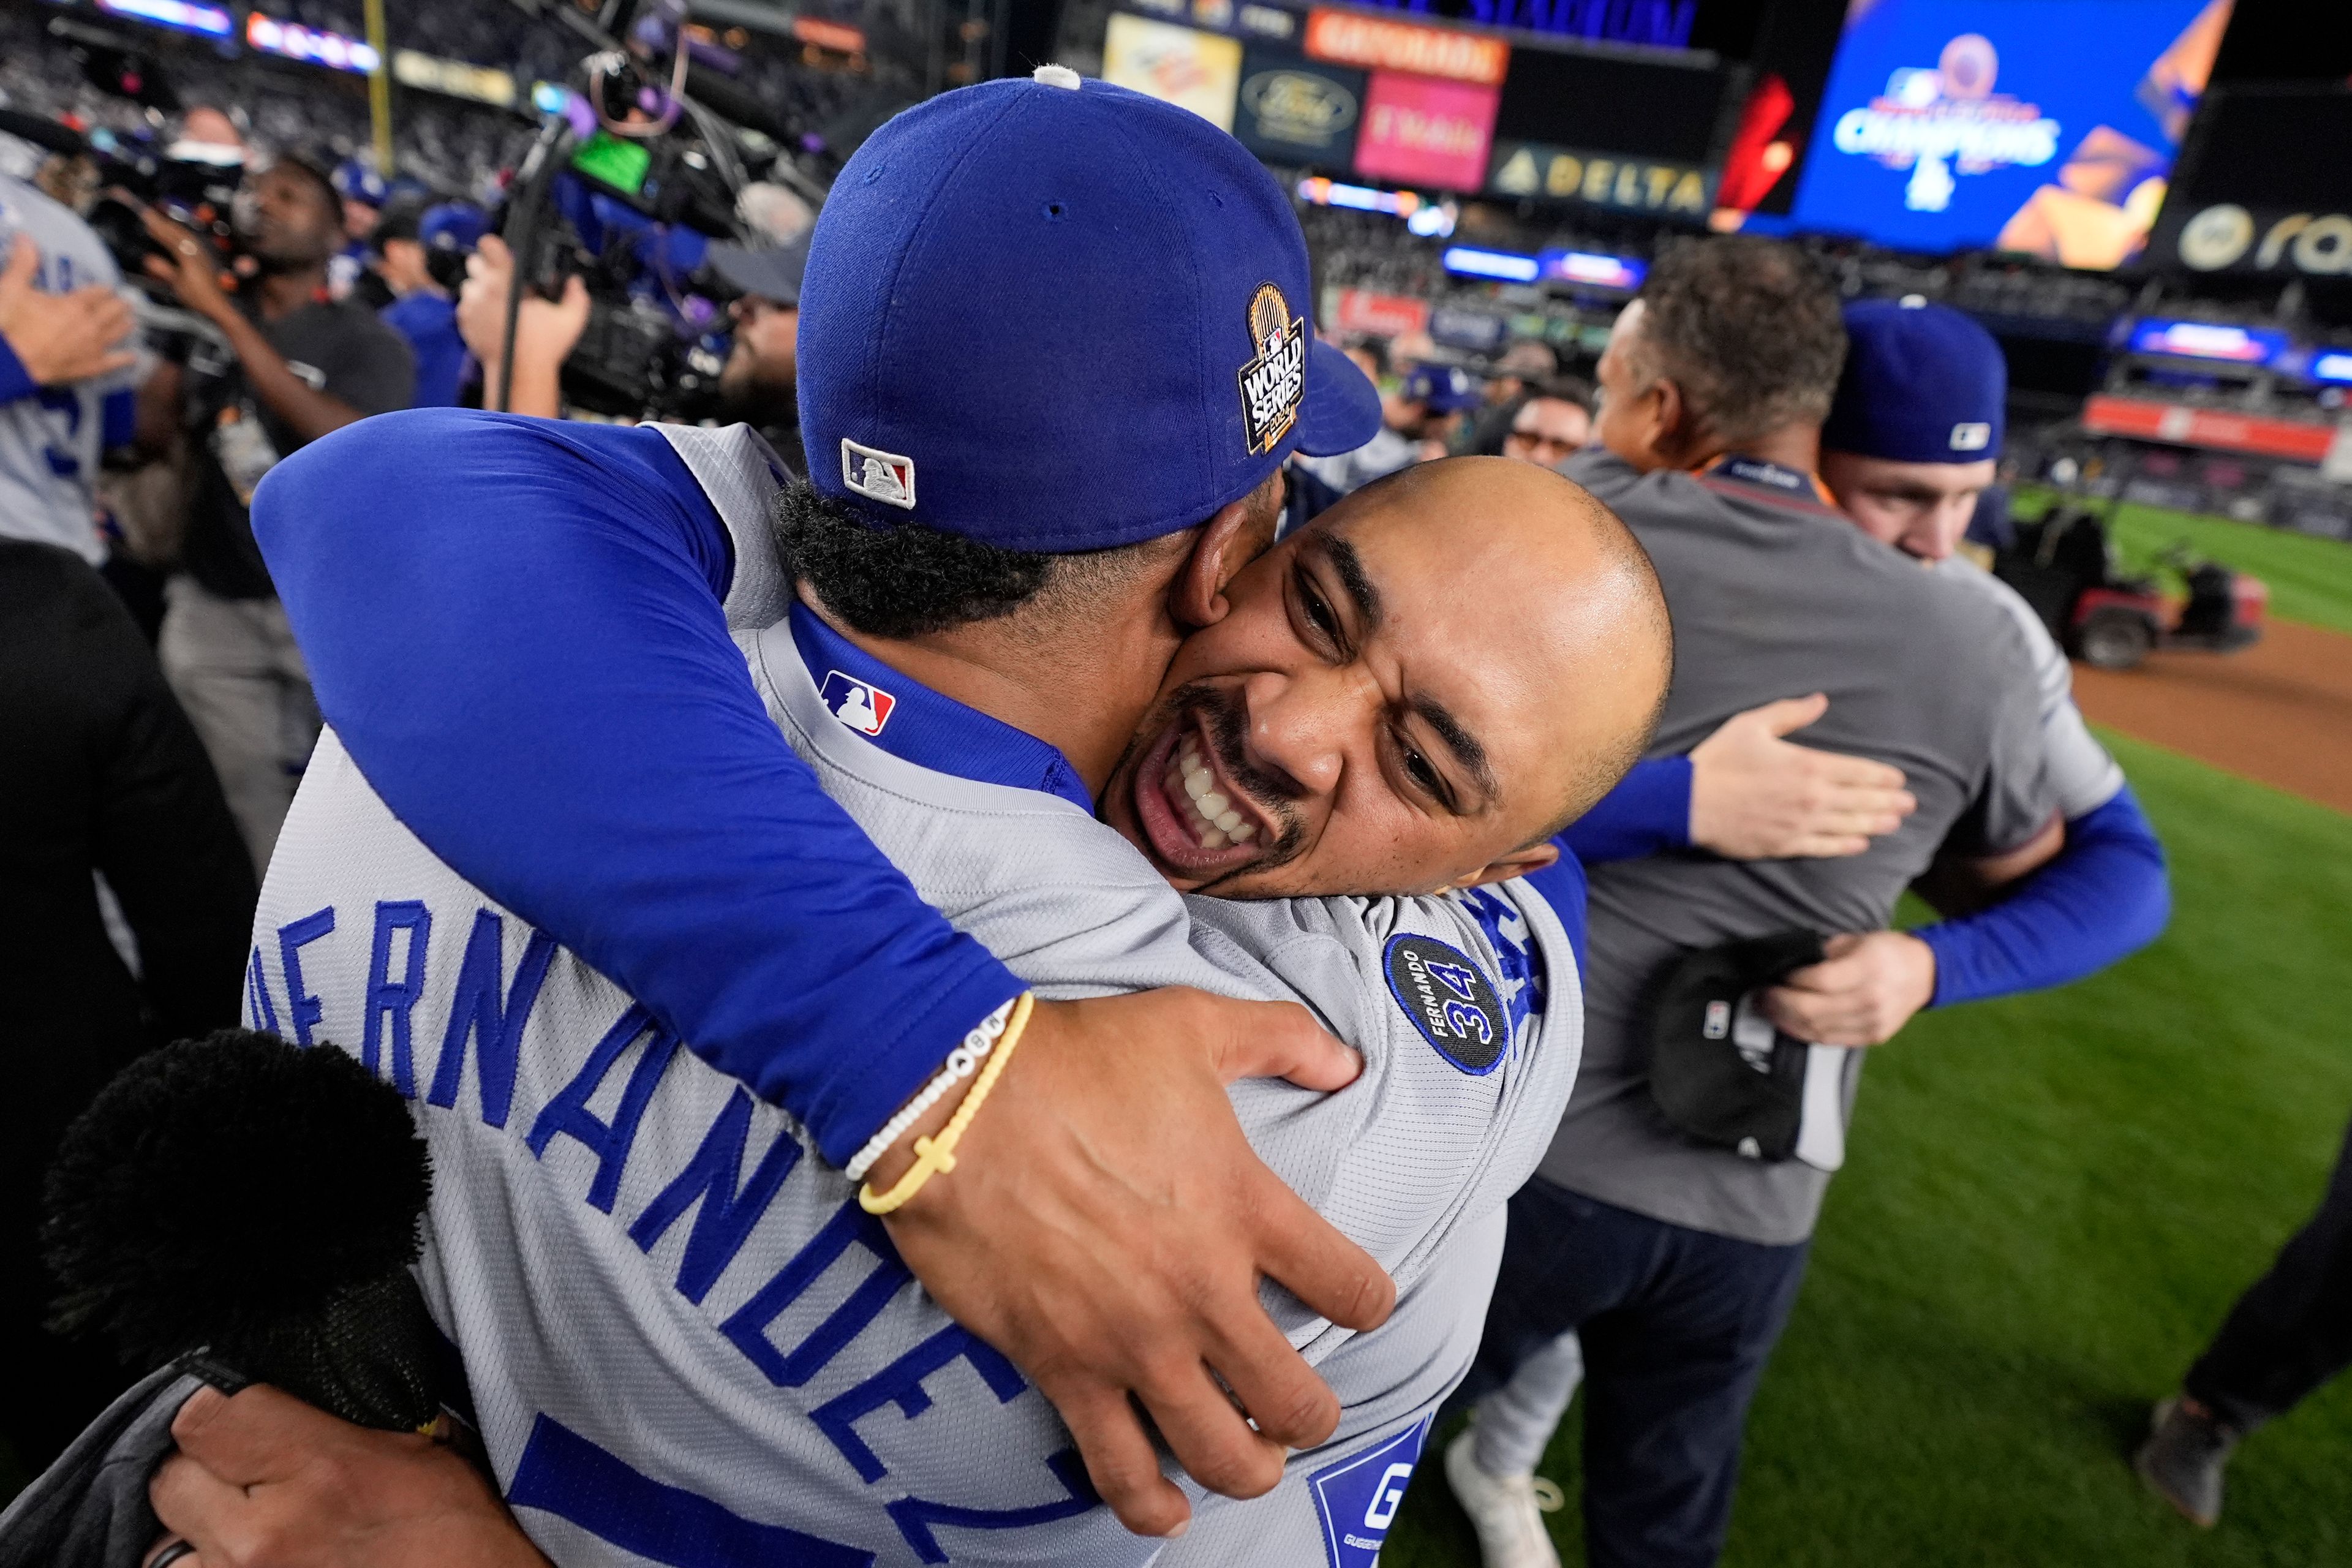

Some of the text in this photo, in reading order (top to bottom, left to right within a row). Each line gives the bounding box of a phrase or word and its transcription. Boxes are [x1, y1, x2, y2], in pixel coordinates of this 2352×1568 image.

[1546, 154, 1705, 213] DELTA
[1244, 337, 1302, 405] WORLD
[1252, 363, 1302, 431] SERIES
[1403, 949, 1449, 1038] FERNANDO
[1423, 959, 1493, 1045] 34
[1363, 1462, 1414, 1530] G
